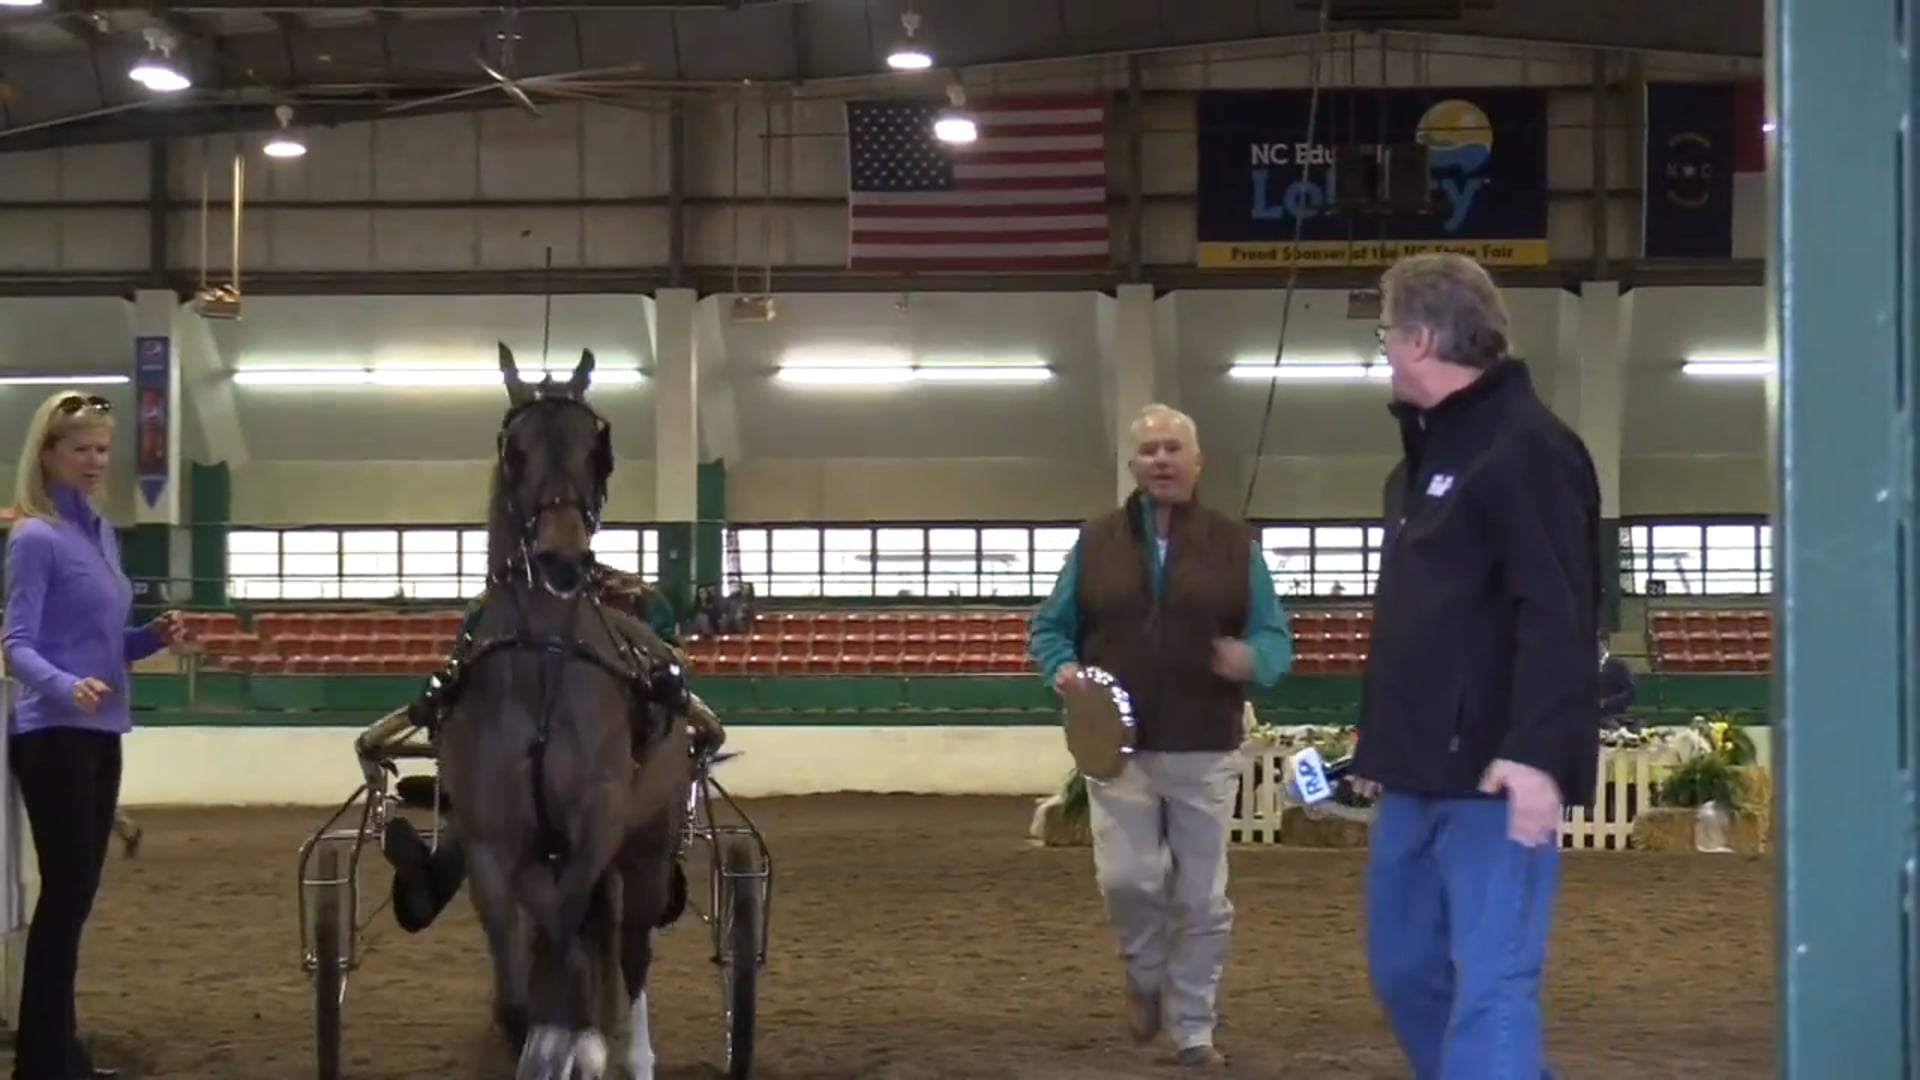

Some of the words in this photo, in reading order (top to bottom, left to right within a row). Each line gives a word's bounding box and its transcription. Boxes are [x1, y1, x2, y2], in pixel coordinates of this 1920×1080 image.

[1250, 143, 1289, 165] NC
[1231, 246, 1277, 261] Proud
[1282, 245, 1346, 263] Sponsor
[1350, 245, 1368, 260] of
[1371, 242, 1398, 259] the
[1483, 243, 1514, 258] Fair
